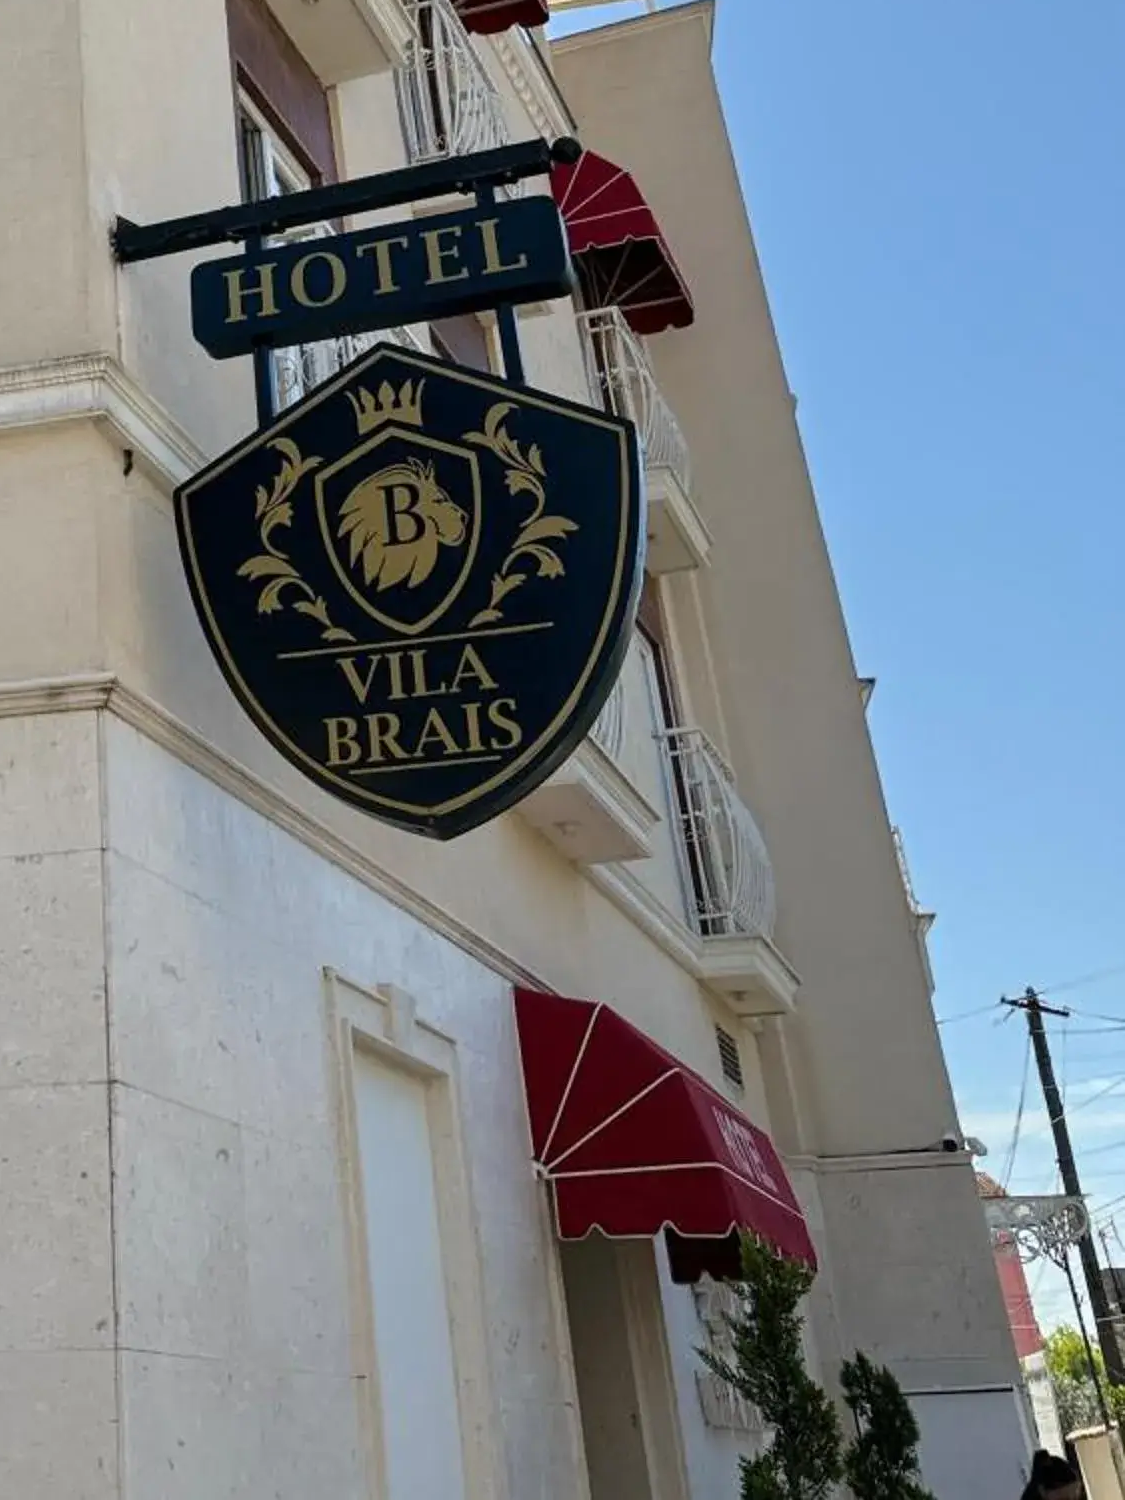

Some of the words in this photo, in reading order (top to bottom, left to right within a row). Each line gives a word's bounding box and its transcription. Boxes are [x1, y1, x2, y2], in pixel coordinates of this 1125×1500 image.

[224, 218, 527, 324] HOTEL
[380, 484, 426, 547] B
[337, 643, 499, 704] VILA
[325, 699, 522, 767] BRAIS
